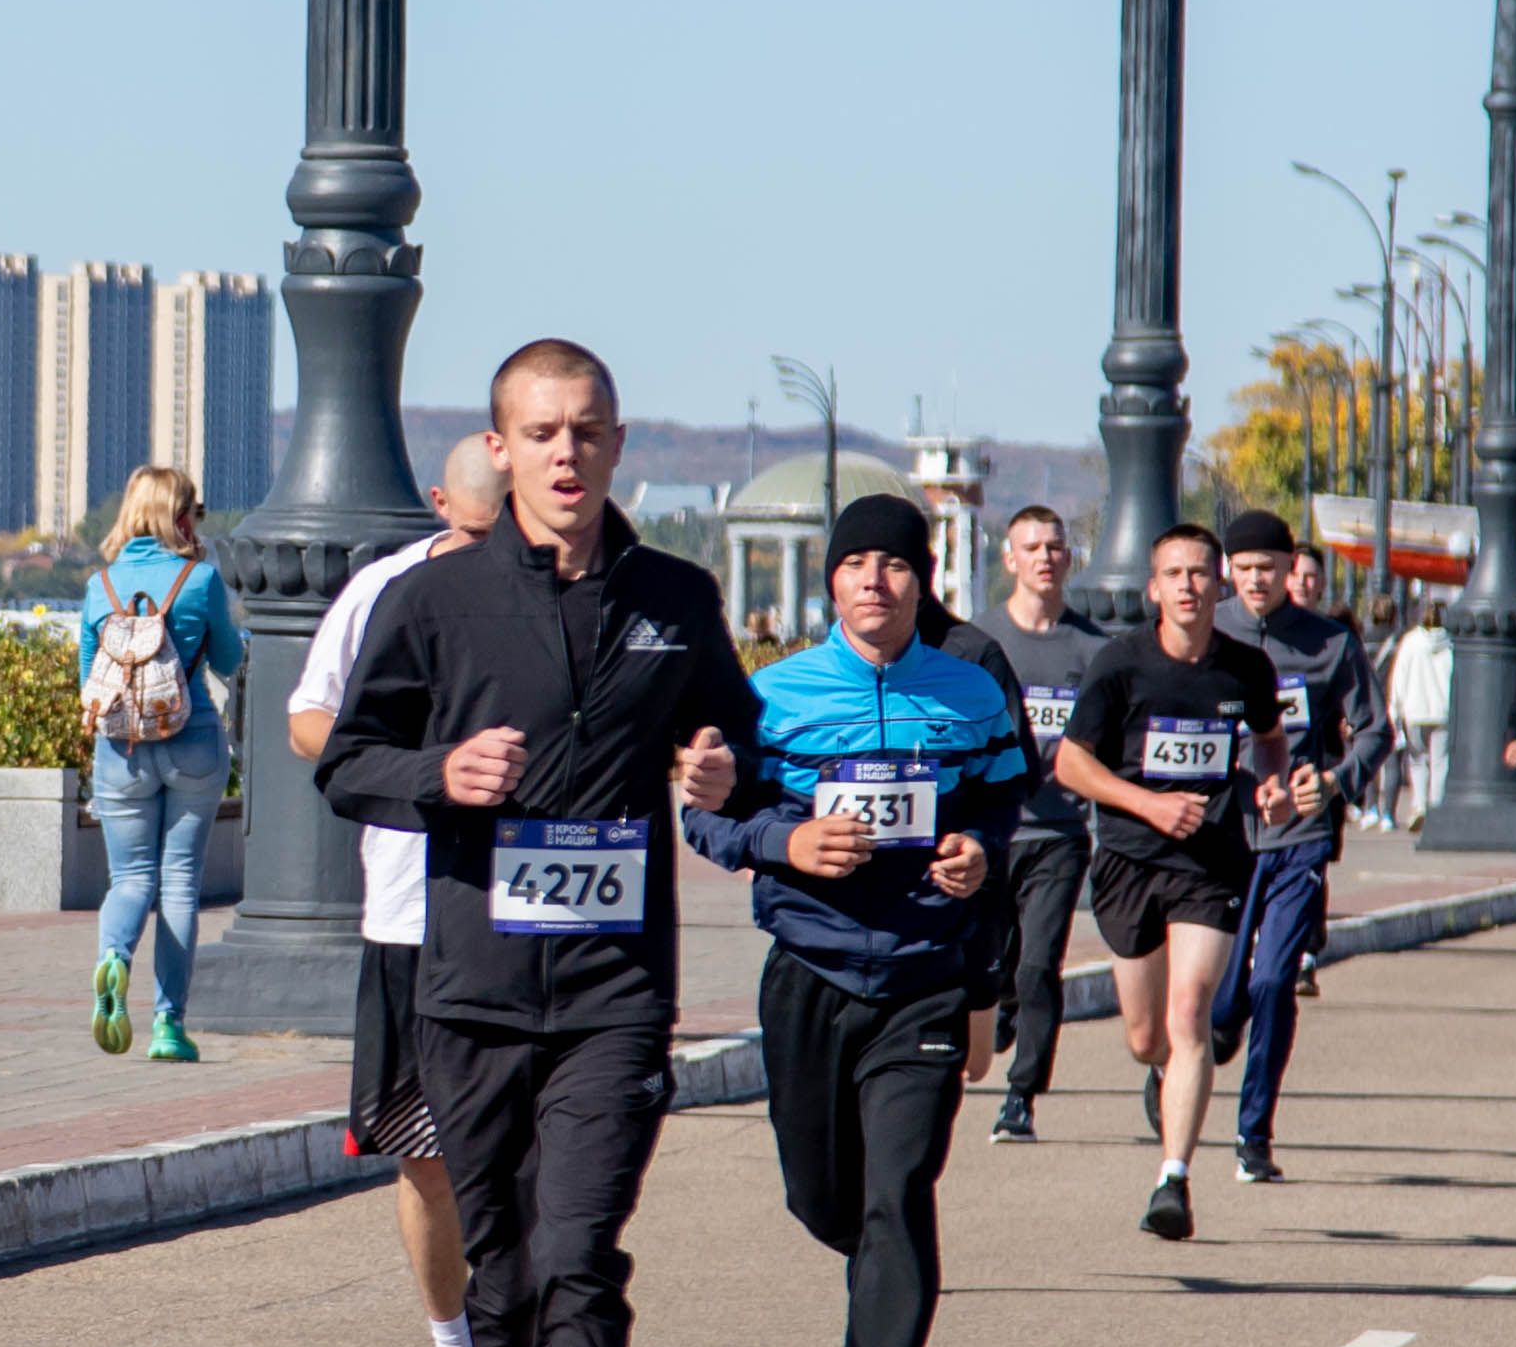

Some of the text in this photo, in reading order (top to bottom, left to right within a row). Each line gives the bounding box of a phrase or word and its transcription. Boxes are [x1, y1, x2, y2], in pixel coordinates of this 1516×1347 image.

[1024, 705, 1070, 727] 285
[1153, 740, 1217, 765] 4319
[555, 824, 588, 836] КРОСС
[555, 835, 597, 847] НАЦИИ
[508, 862, 624, 907] 4276
